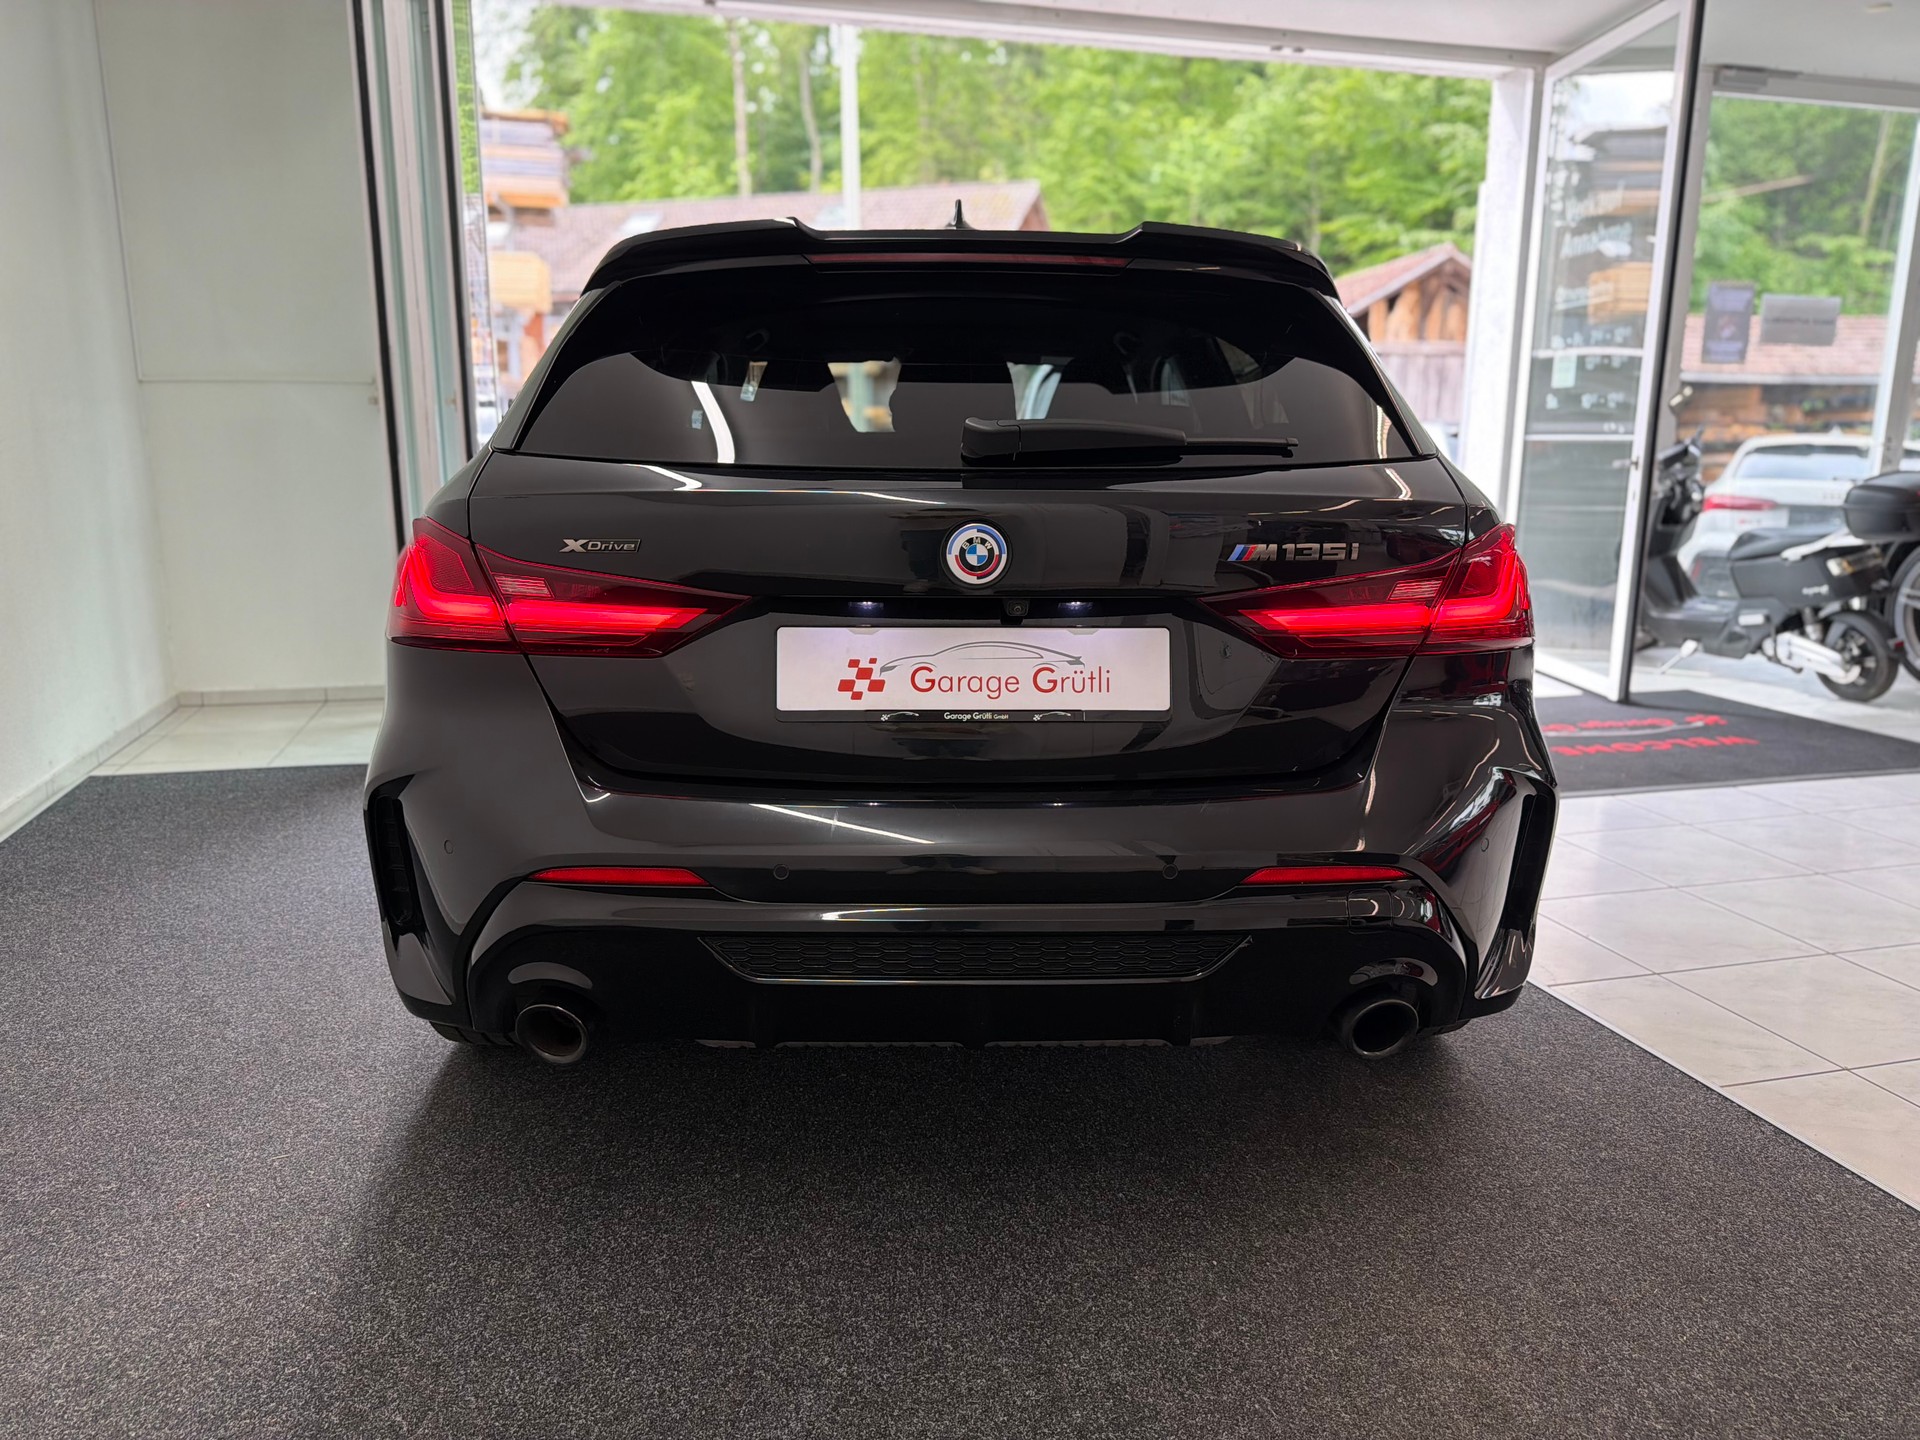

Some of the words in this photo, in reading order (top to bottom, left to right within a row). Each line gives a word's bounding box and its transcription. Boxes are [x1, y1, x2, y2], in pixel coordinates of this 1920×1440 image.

[961, 536, 993, 550] BMW
[1248, 543, 1360, 561] M135i
[910, 666, 1020, 700] Garage
[1032, 666, 1111, 693] Grütli
[943, 711, 972, 722] Garage
[972, 711, 993, 720] Grütli
